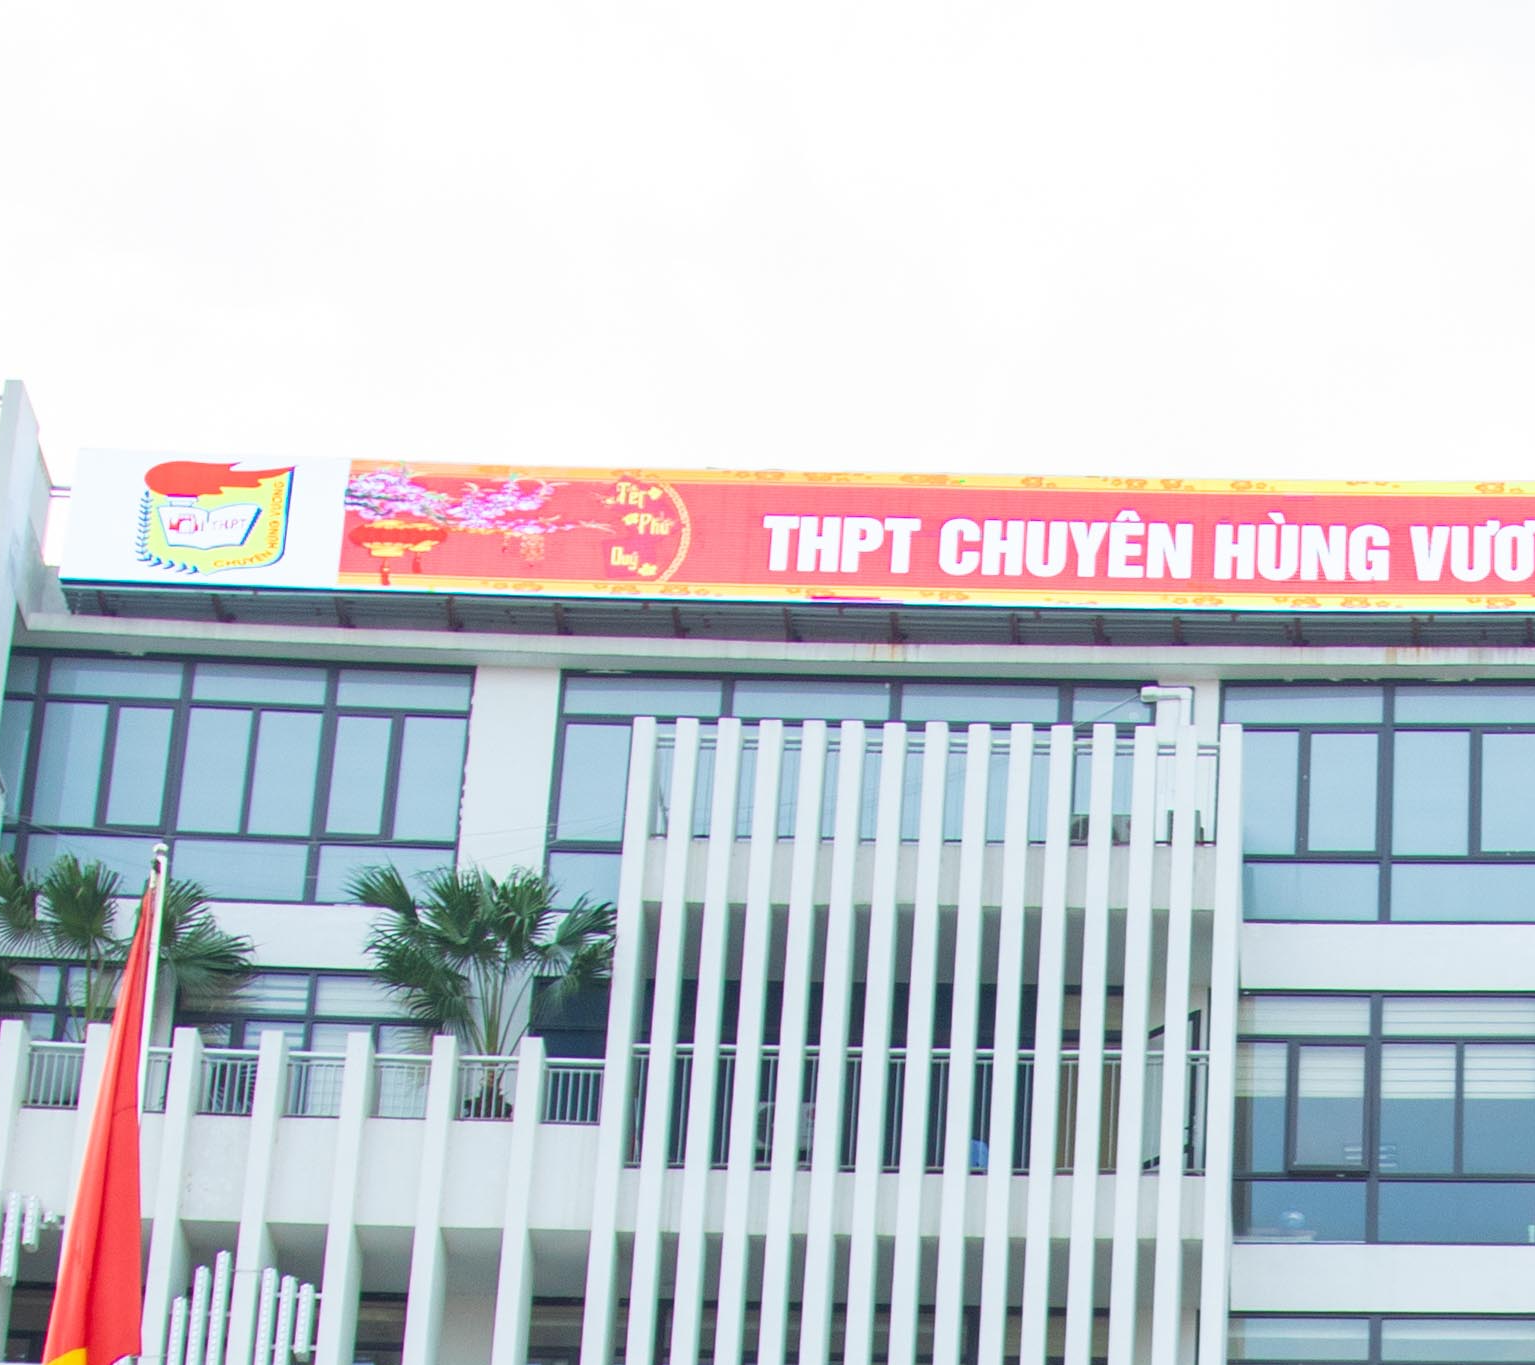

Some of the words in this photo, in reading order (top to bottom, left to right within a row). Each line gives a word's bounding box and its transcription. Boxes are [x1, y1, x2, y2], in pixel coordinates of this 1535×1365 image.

[763, 514, 922, 574] THPT
[937, 509, 1193, 580] CHUYÊN
[1213, 511, 1391, 583] HÙNG
